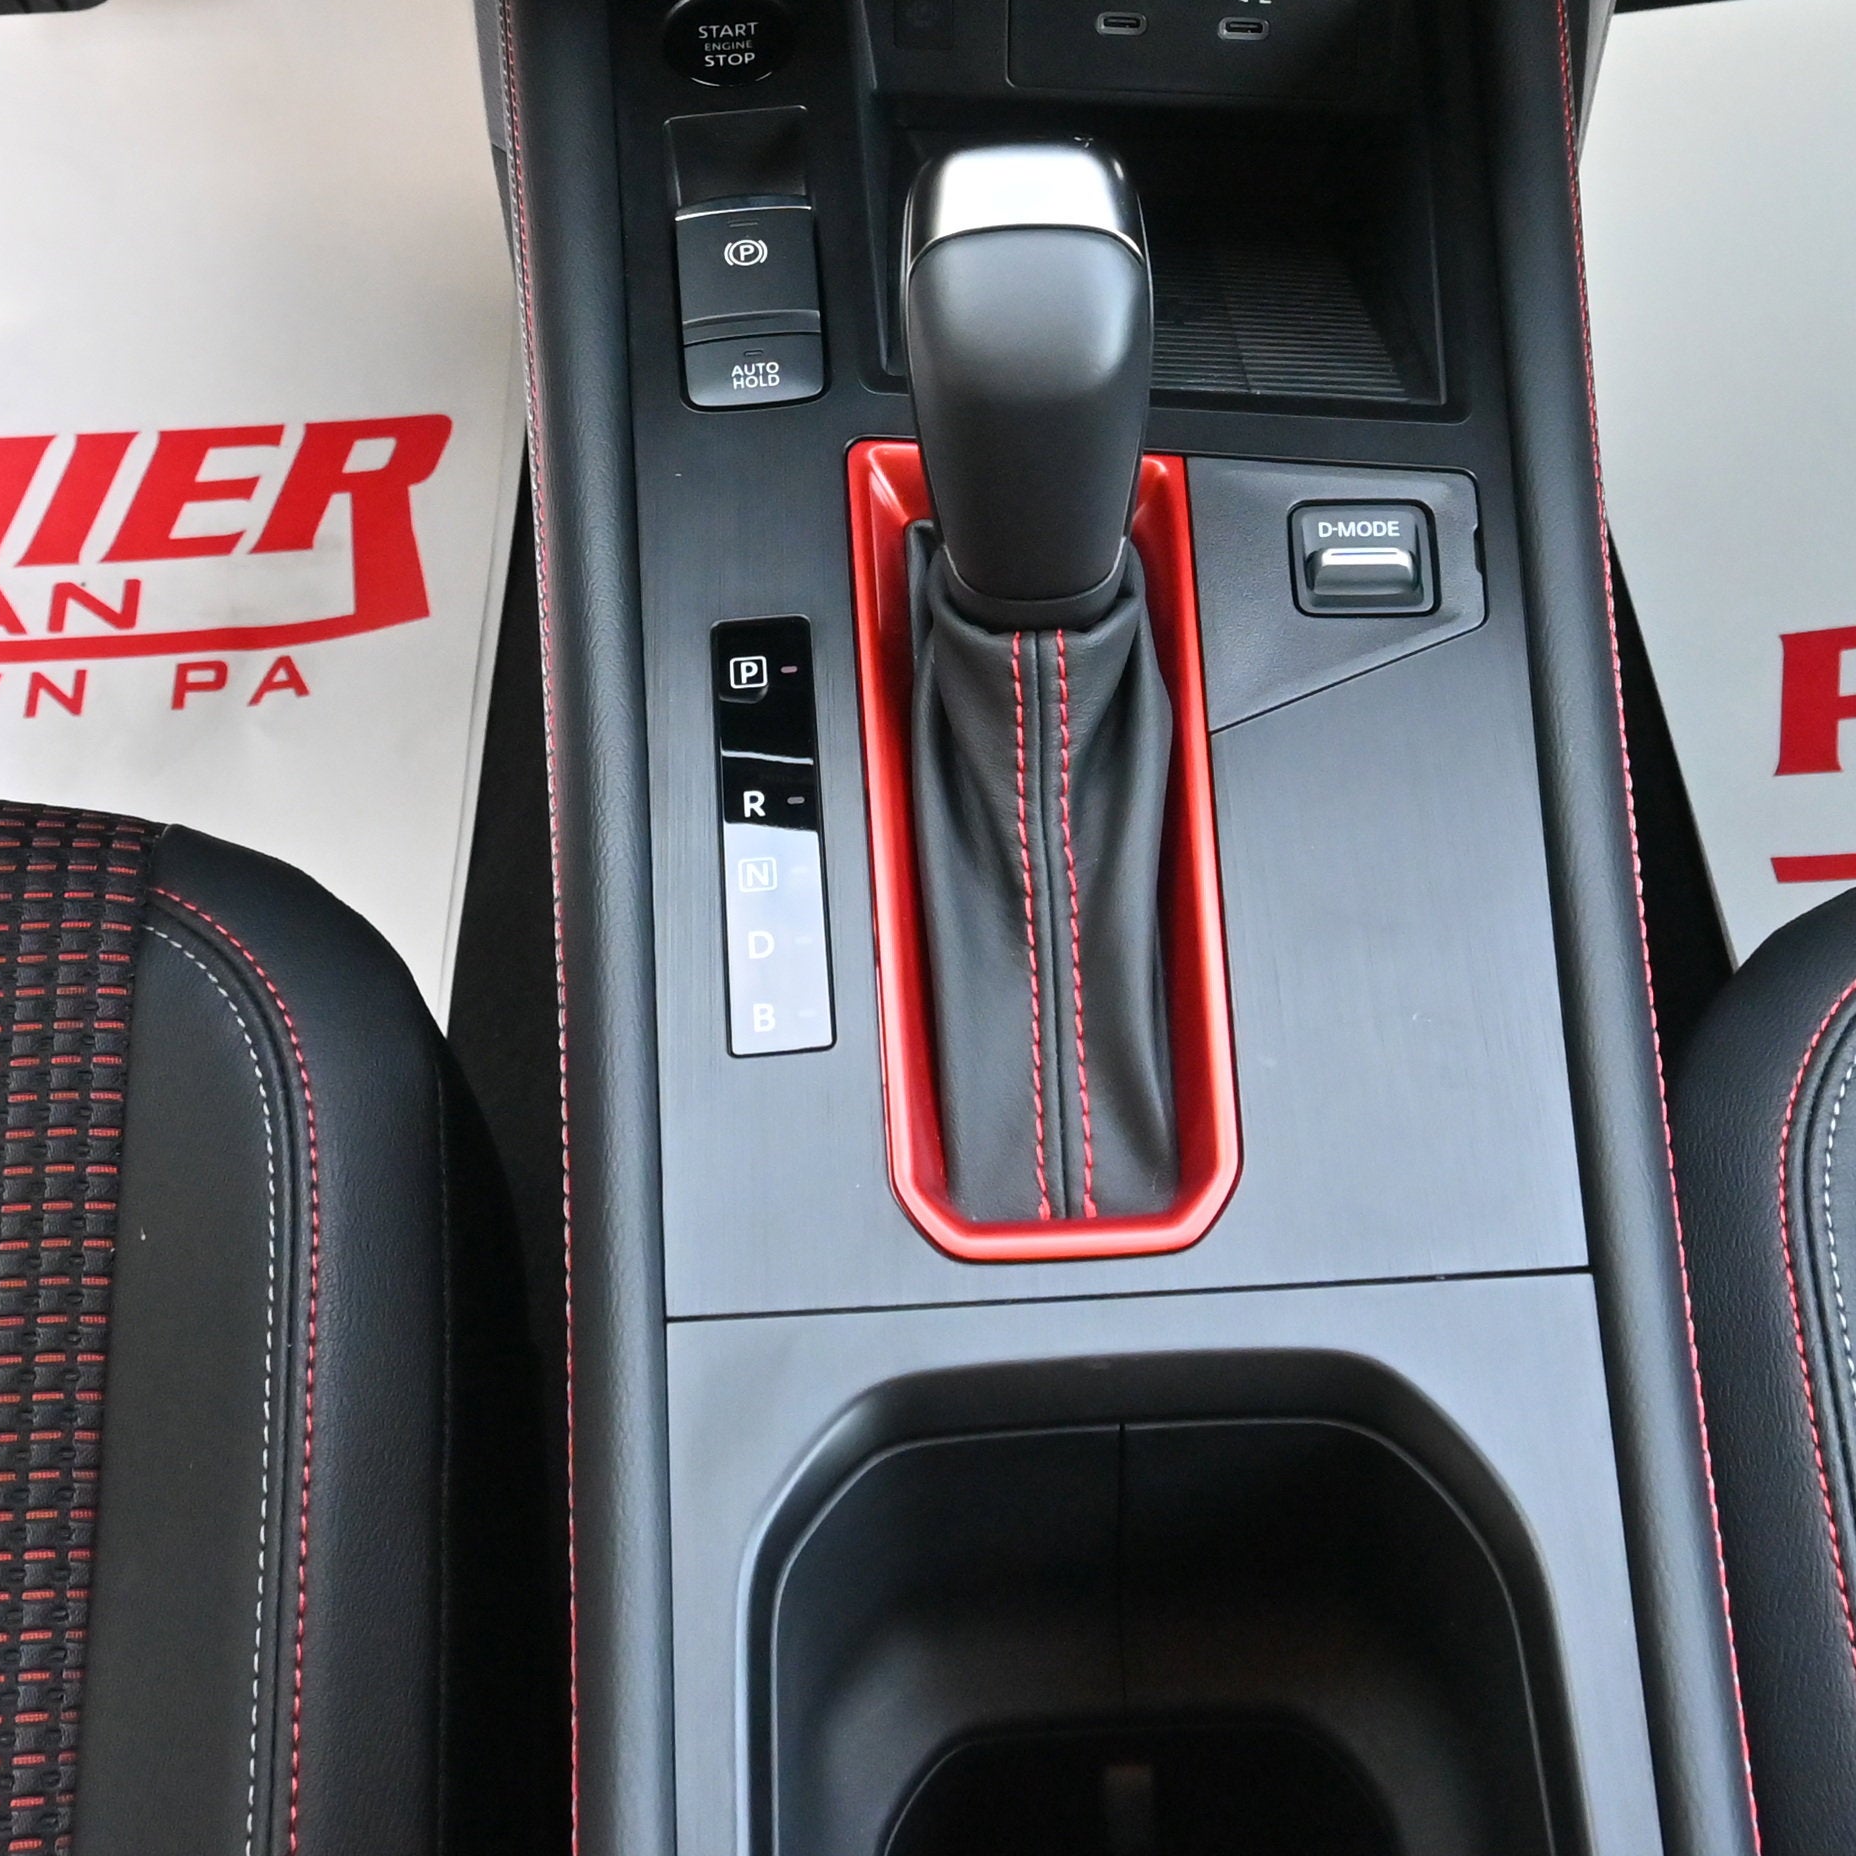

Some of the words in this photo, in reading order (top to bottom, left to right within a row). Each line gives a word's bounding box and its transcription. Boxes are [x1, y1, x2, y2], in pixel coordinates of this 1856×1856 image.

[698, 22, 759, 39] START
[704, 40, 753, 52] ENGINE
[704, 52, 756, 67] STOP
[731, 361, 779, 377] AUTO
[732, 374, 780, 390] HOLD
[1318, 520, 1401, 538] D-MODE
[171, 655, 310, 710] PA
[740, 661, 758, 684] P
[743, 790, 766, 817] R
[747, 863, 768, 887] N
[747, 930, 775, 959] D
[752, 1003, 776, 1032] B
